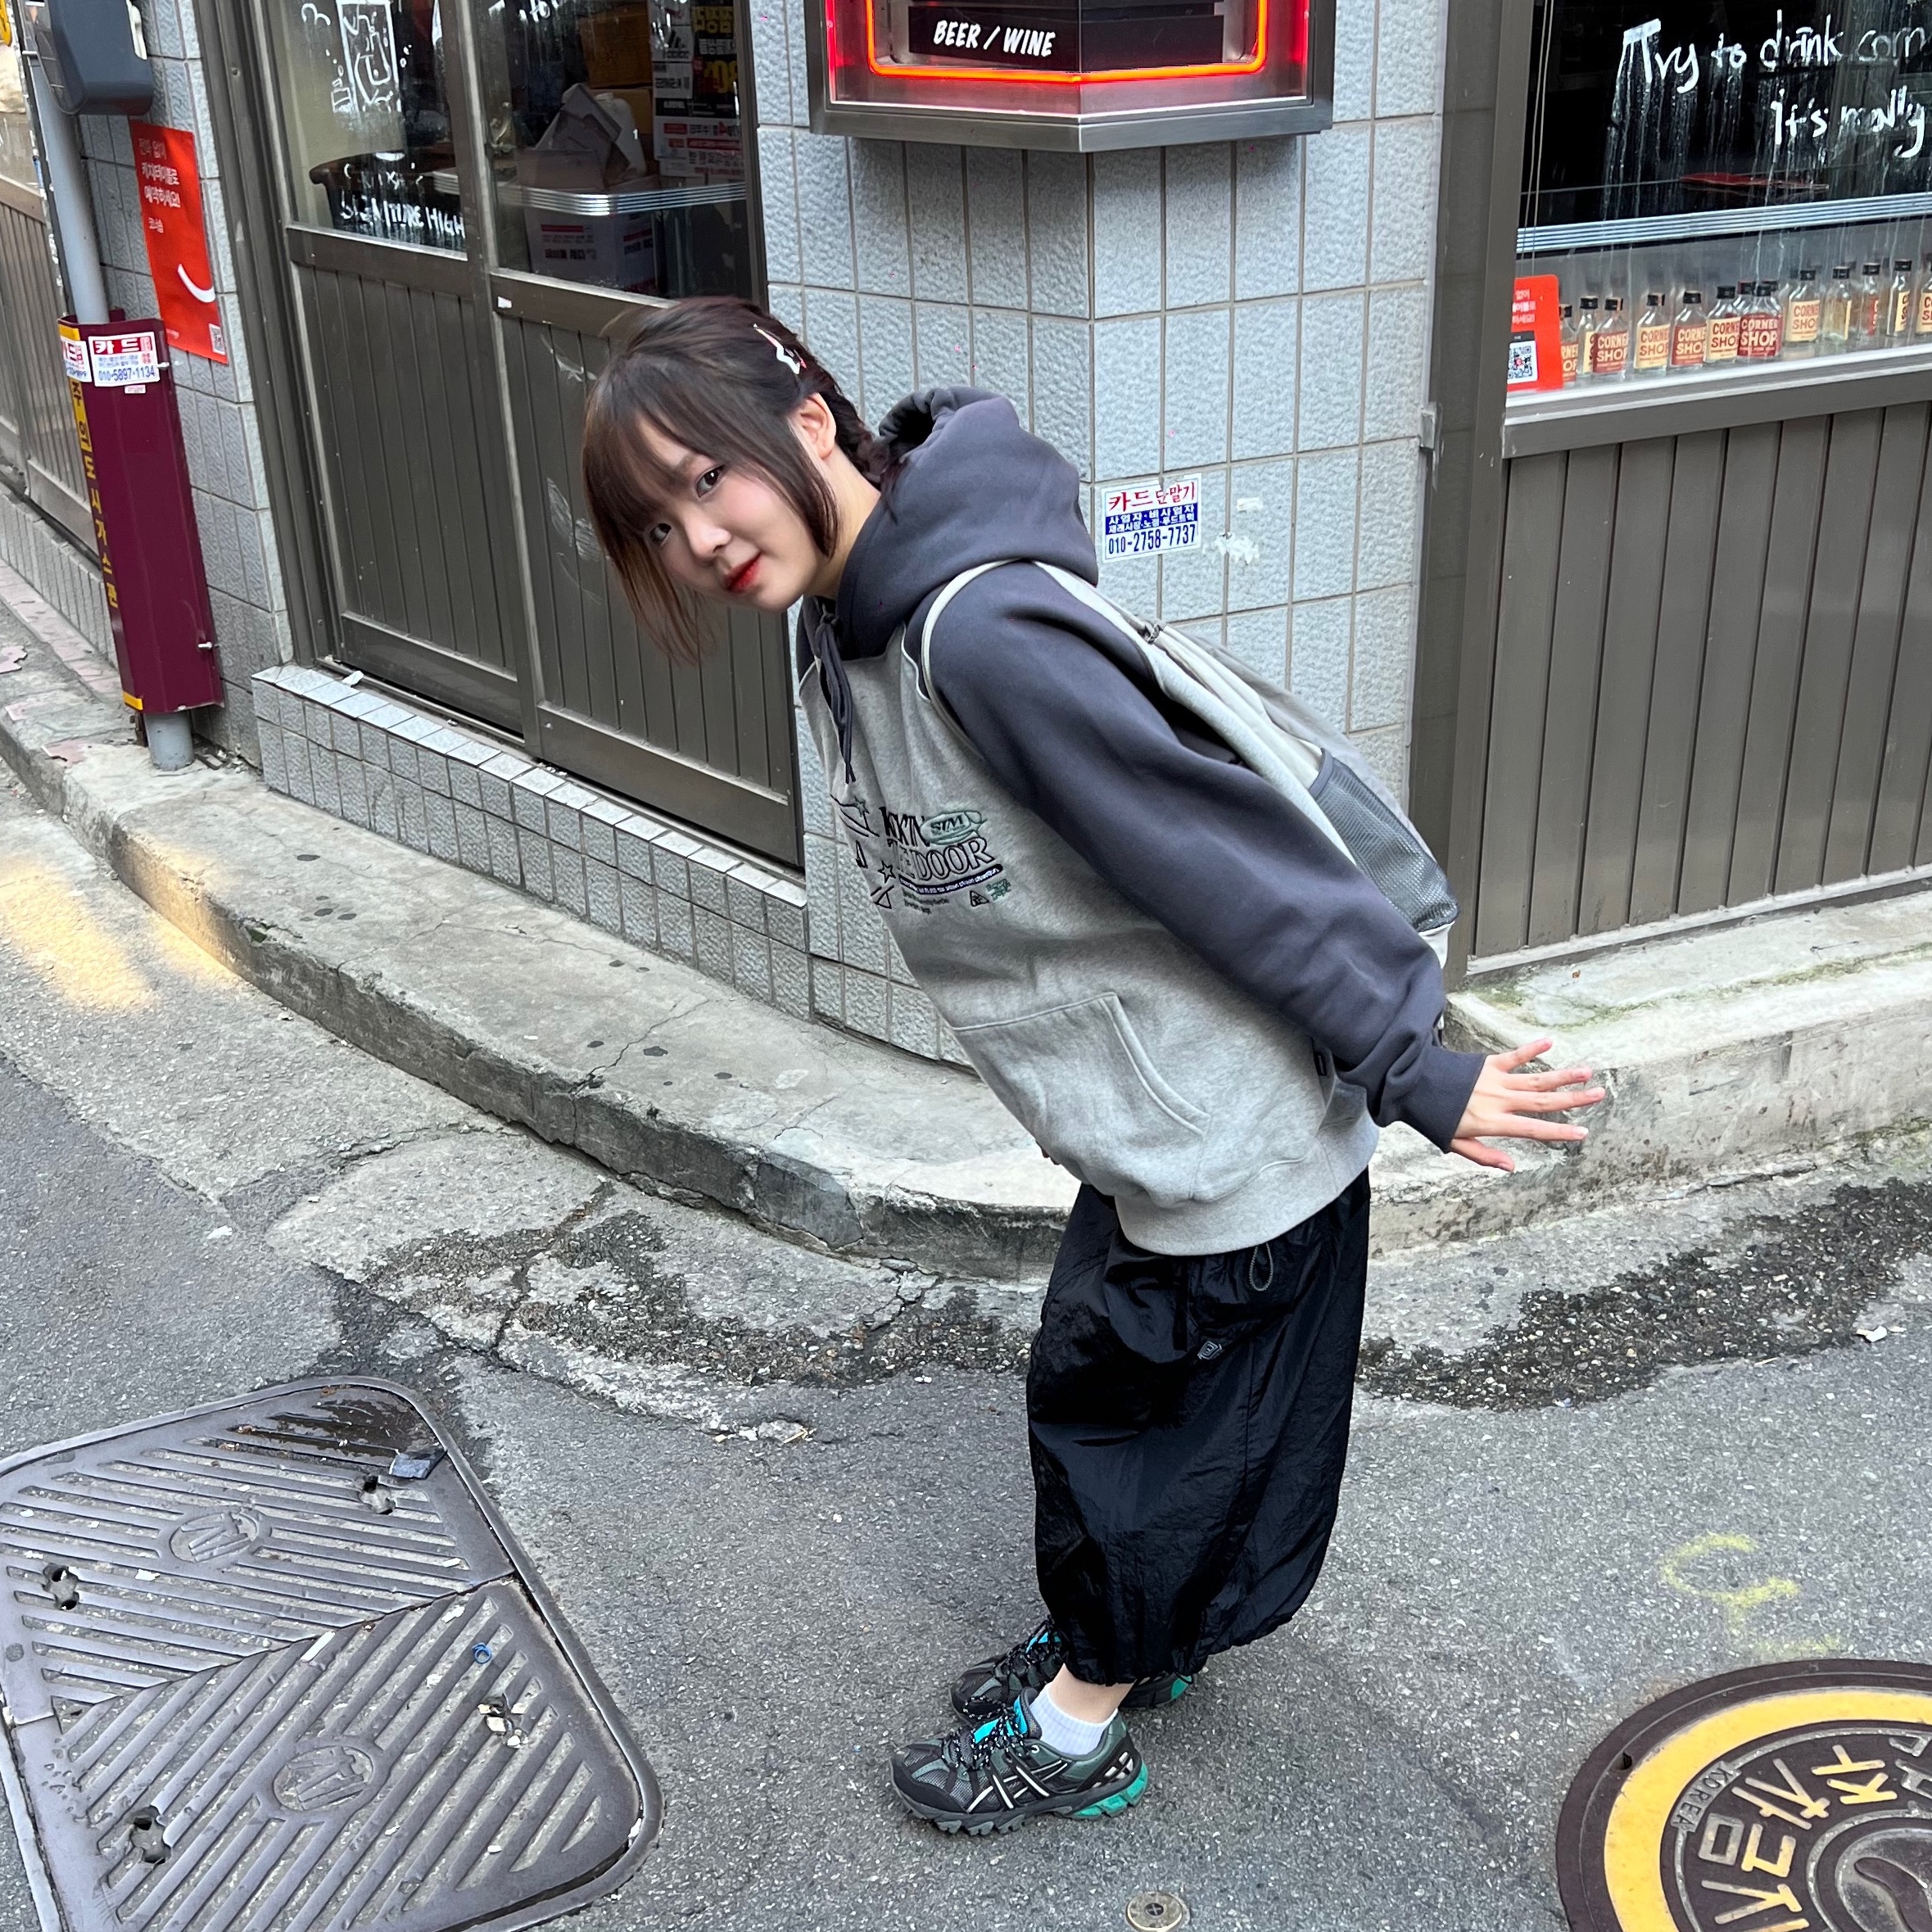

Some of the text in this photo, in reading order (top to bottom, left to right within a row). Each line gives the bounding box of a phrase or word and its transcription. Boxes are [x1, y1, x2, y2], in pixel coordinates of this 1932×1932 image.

[934, 20, 981, 48] BEER
[1003, 27, 1056, 57] WINE
[1618, 18, 1699, 93] Try
[1711, 33, 1747, 68] to
[1761, 9, 1844, 71] drink
[1794, 304, 1820, 318] CORNE
[1793, 317, 1818, 330] SHO
[1598, 333, 1629, 350] CORNE
[1640, 328, 1668, 343] CORNE
[1677, 327, 1706, 342] CORNE
[1711, 334, 1739, 348] SHO
[1740, 330, 1777, 346] SHOP
[94, 337, 140, 355] 카드
[1676, 341, 1704, 355] SHO
[1108, 482, 1196, 513] 카드 단말기
[1108, 524, 1196, 554] 010-2758-7737
[1672, 1767, 1734, 1826] KOREA
